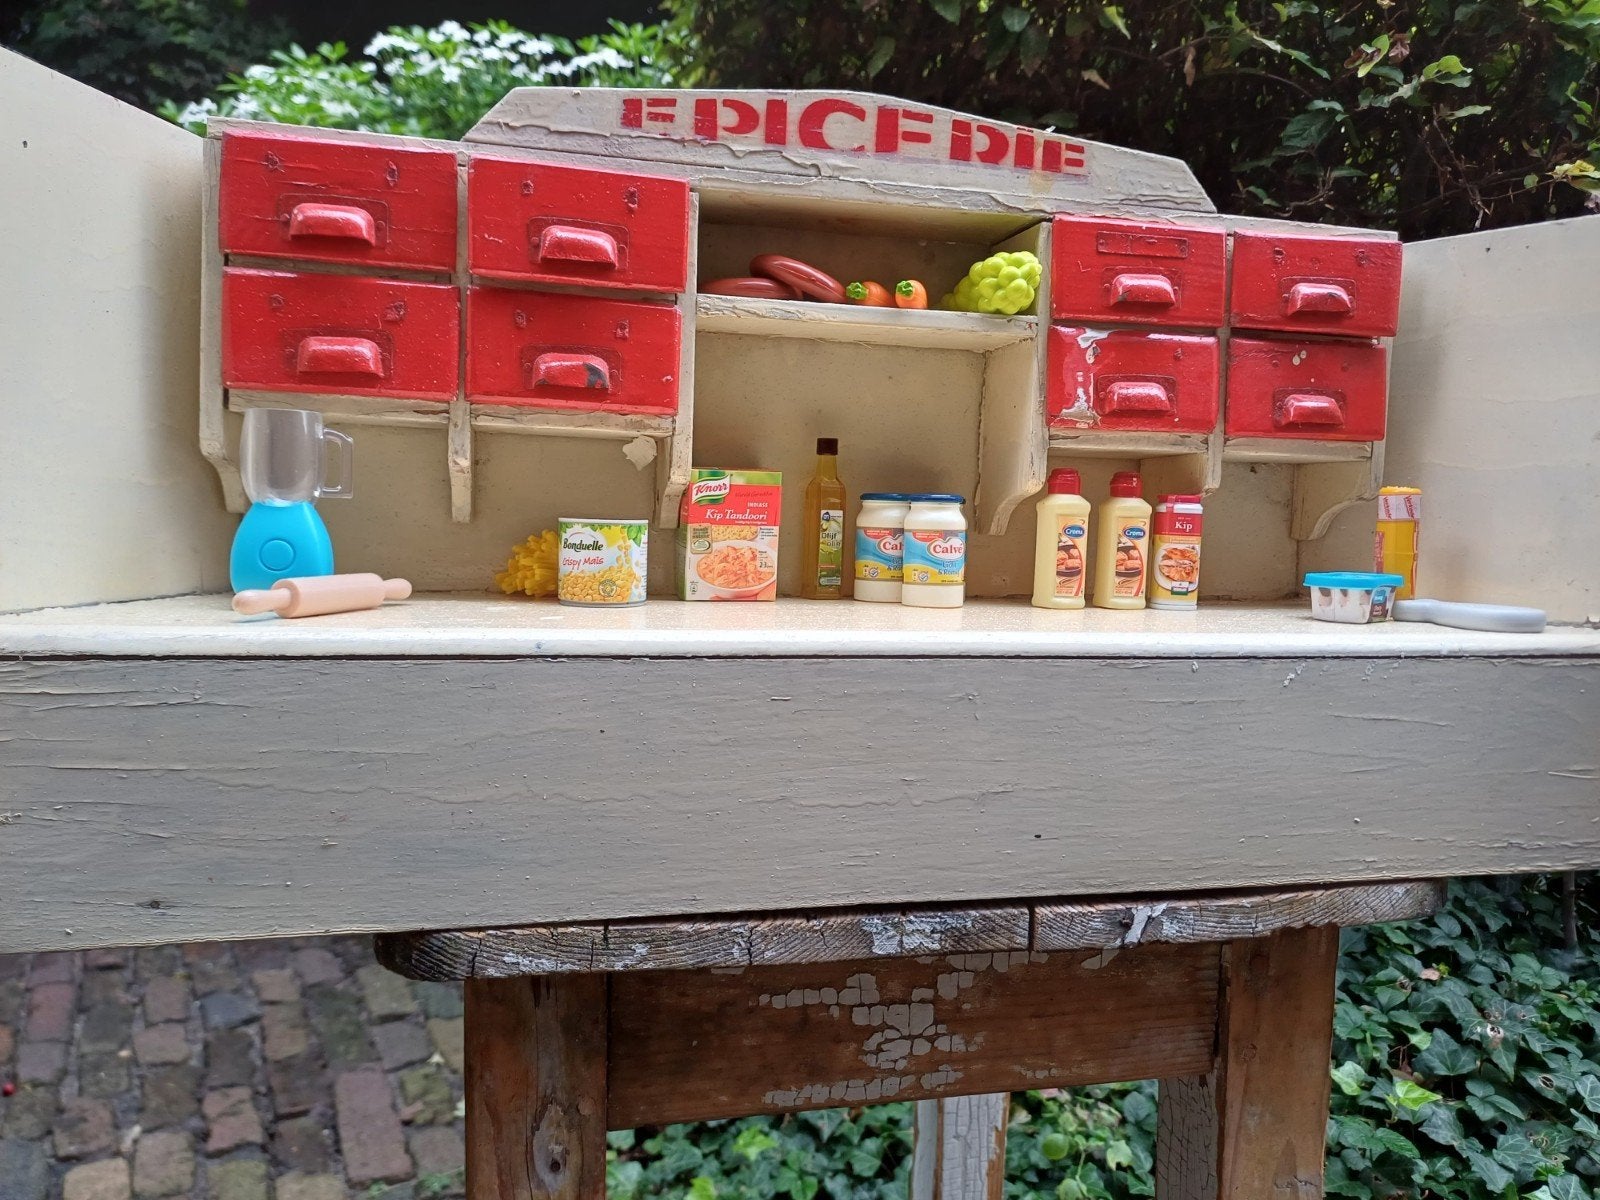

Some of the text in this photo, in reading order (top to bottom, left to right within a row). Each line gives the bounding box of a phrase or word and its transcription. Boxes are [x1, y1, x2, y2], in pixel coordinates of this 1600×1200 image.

[694, 482, 728, 497] Knorr
[705, 508, 767, 521] Kip Tandoori
[1175, 521, 1193, 533] Kip
[563, 538, 604, 552] Bonduelle
[882, 541, 903, 551] Cal
[932, 542, 963, 554] Calvé
